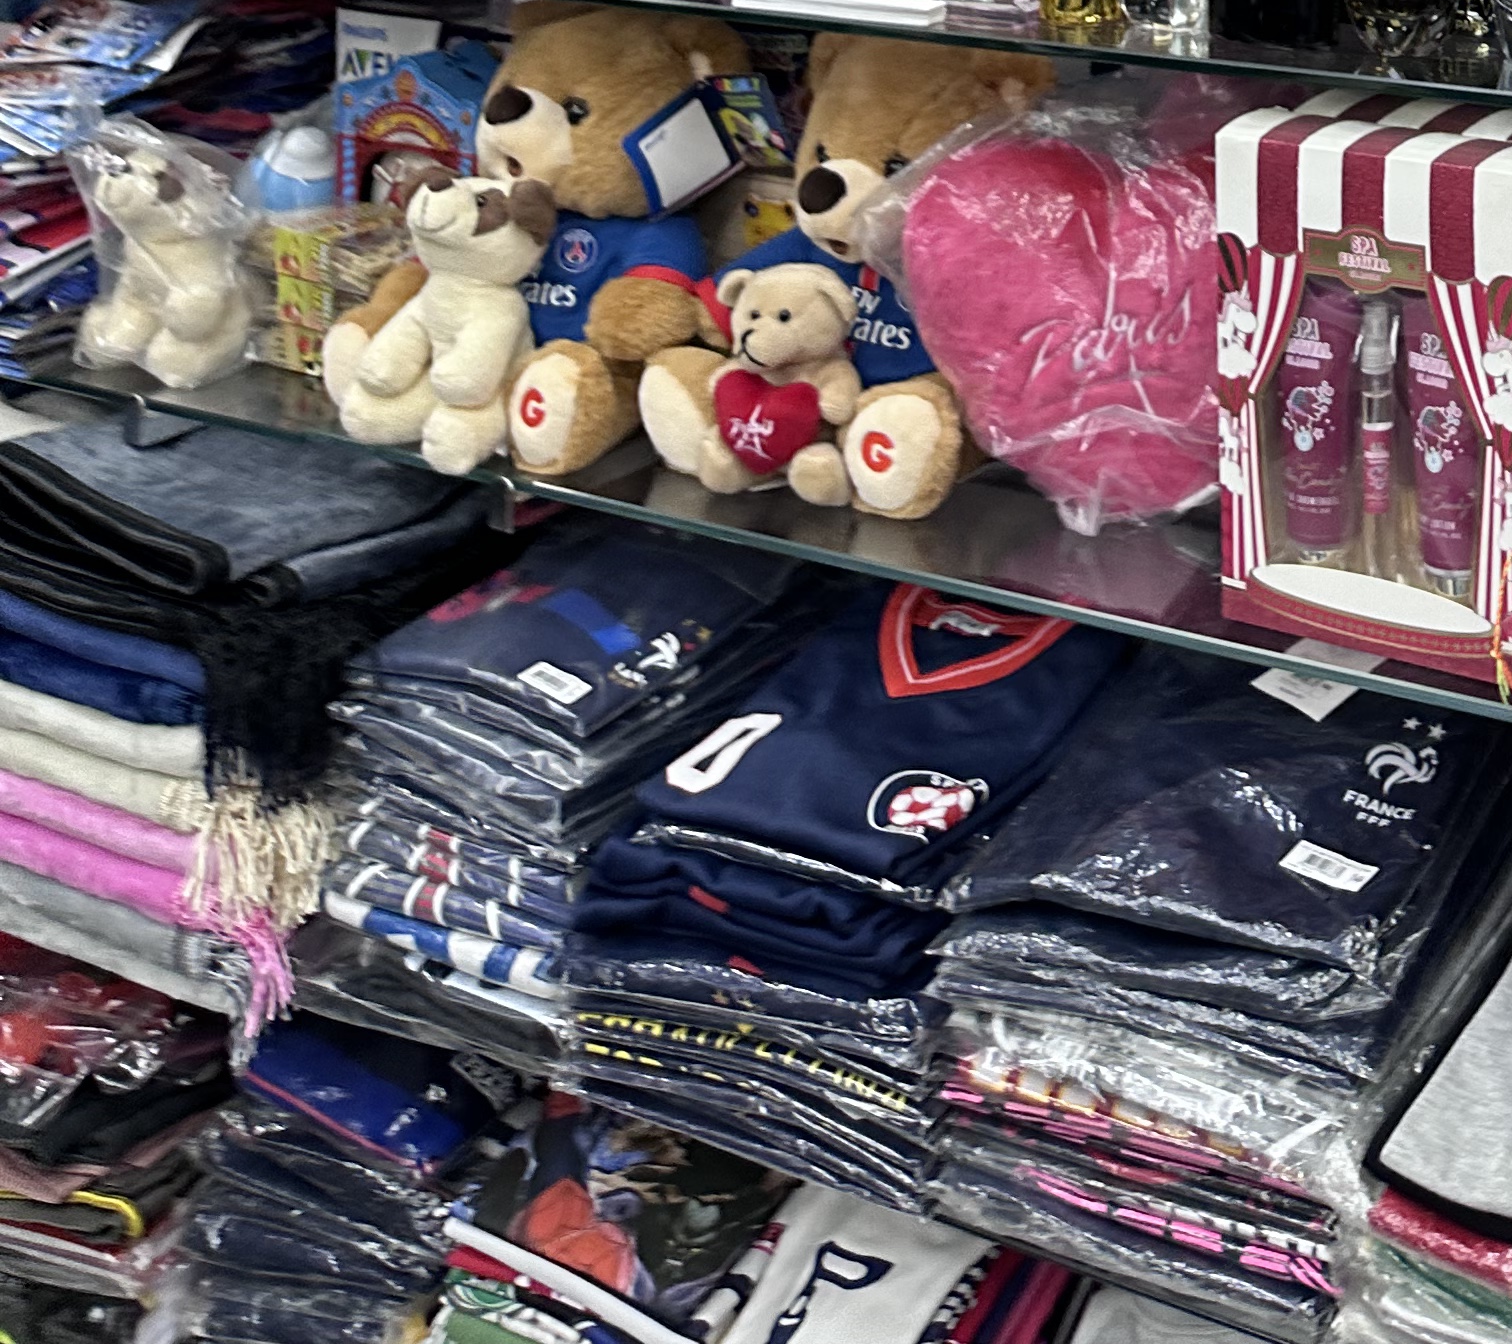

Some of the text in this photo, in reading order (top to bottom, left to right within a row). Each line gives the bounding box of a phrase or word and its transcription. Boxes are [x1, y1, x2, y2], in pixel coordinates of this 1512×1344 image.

[1350, 235, 1379, 257] SPA
[1338, 251, 1392, 274] FESTIVAL
[1017, 299, 1193, 387] Paris
[1290, 316, 1321, 341] SPA
[519, 387, 546, 429] G
[860, 430, 896, 474] G
[1342, 788, 1416, 823] FRANCE
[1355, 809, 1391, 829] FFF
